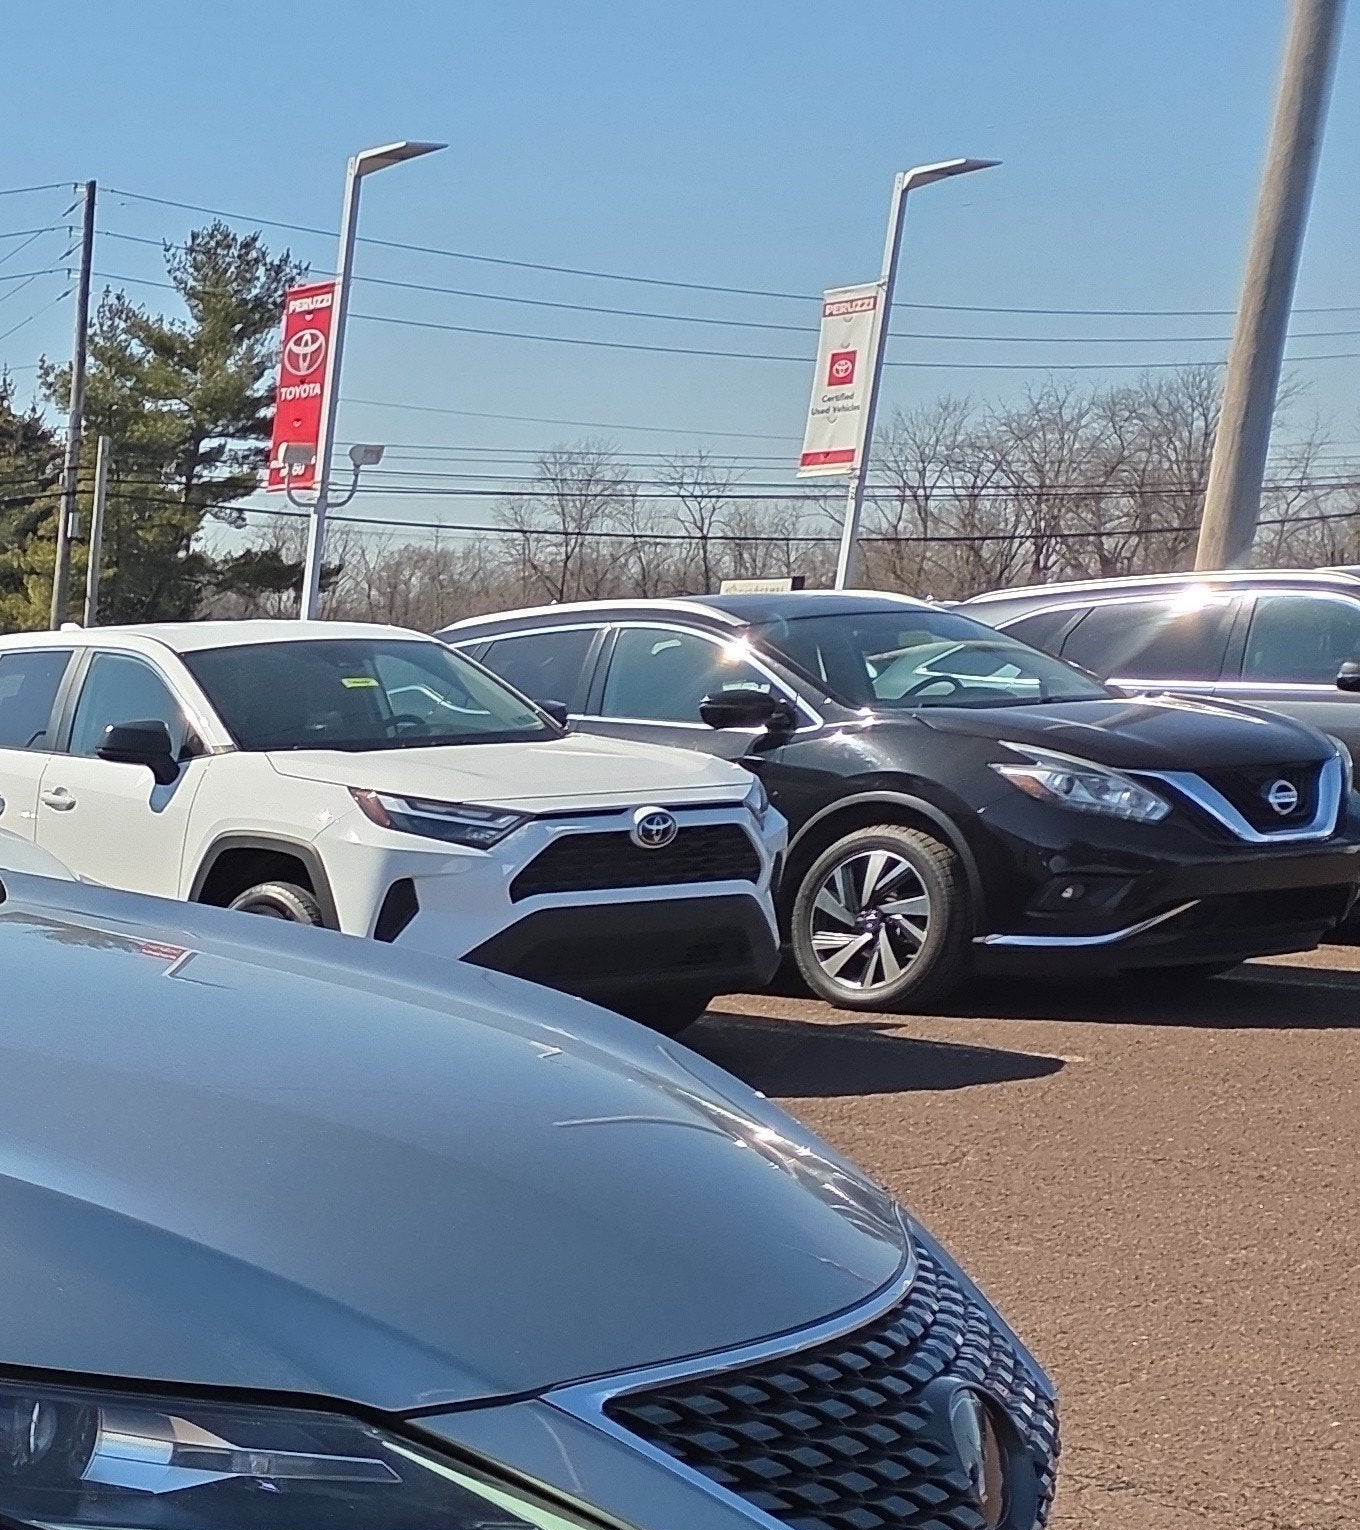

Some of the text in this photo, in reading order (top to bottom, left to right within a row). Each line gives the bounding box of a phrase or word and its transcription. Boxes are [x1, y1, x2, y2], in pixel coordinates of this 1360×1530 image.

[289, 293, 332, 314] PERUZZI
[825, 298, 874, 316] PERUZZI
[280, 383, 321, 401] TOYOTA
[821, 392, 854, 402] Certified
[811, 406, 830, 415] Used
